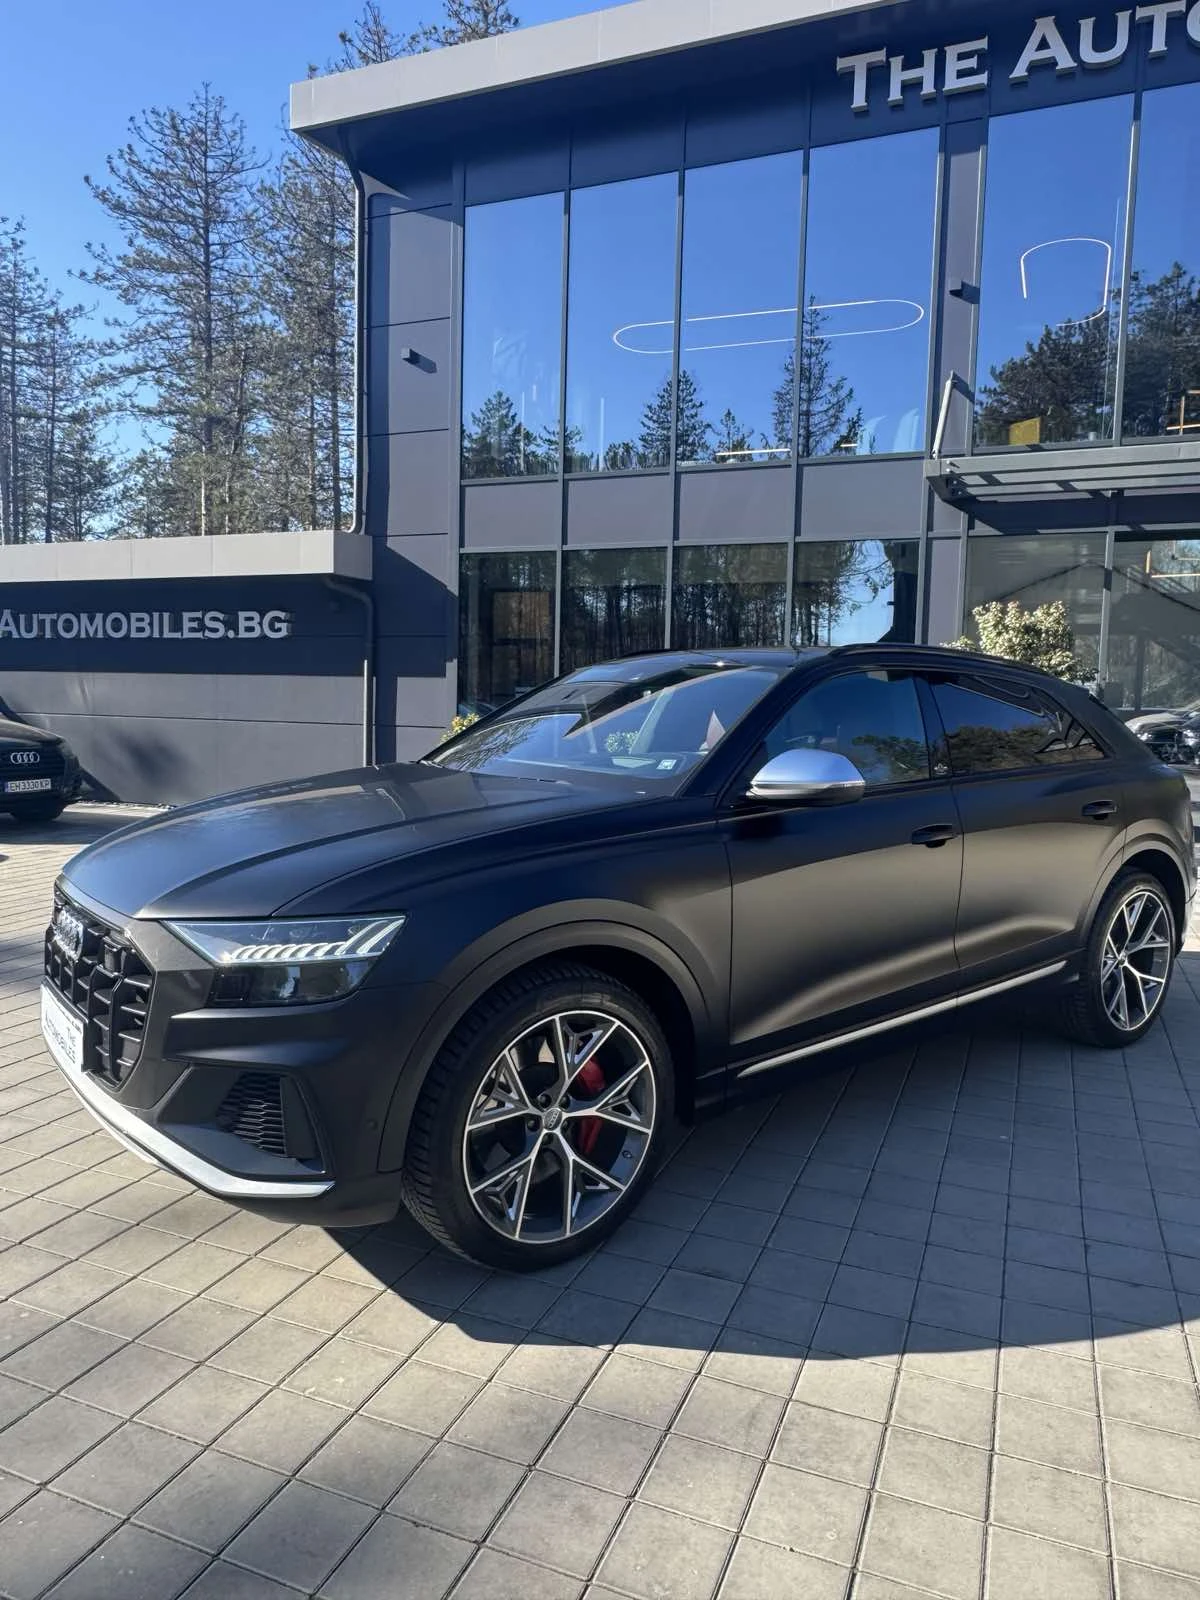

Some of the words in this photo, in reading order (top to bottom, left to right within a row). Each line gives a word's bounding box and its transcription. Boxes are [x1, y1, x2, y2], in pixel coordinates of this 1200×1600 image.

[836, 36, 988, 110] THE
[1009, 0, 1200, 80] AUT
[0, 609, 289, 639] AUTOMOBILES.BG
